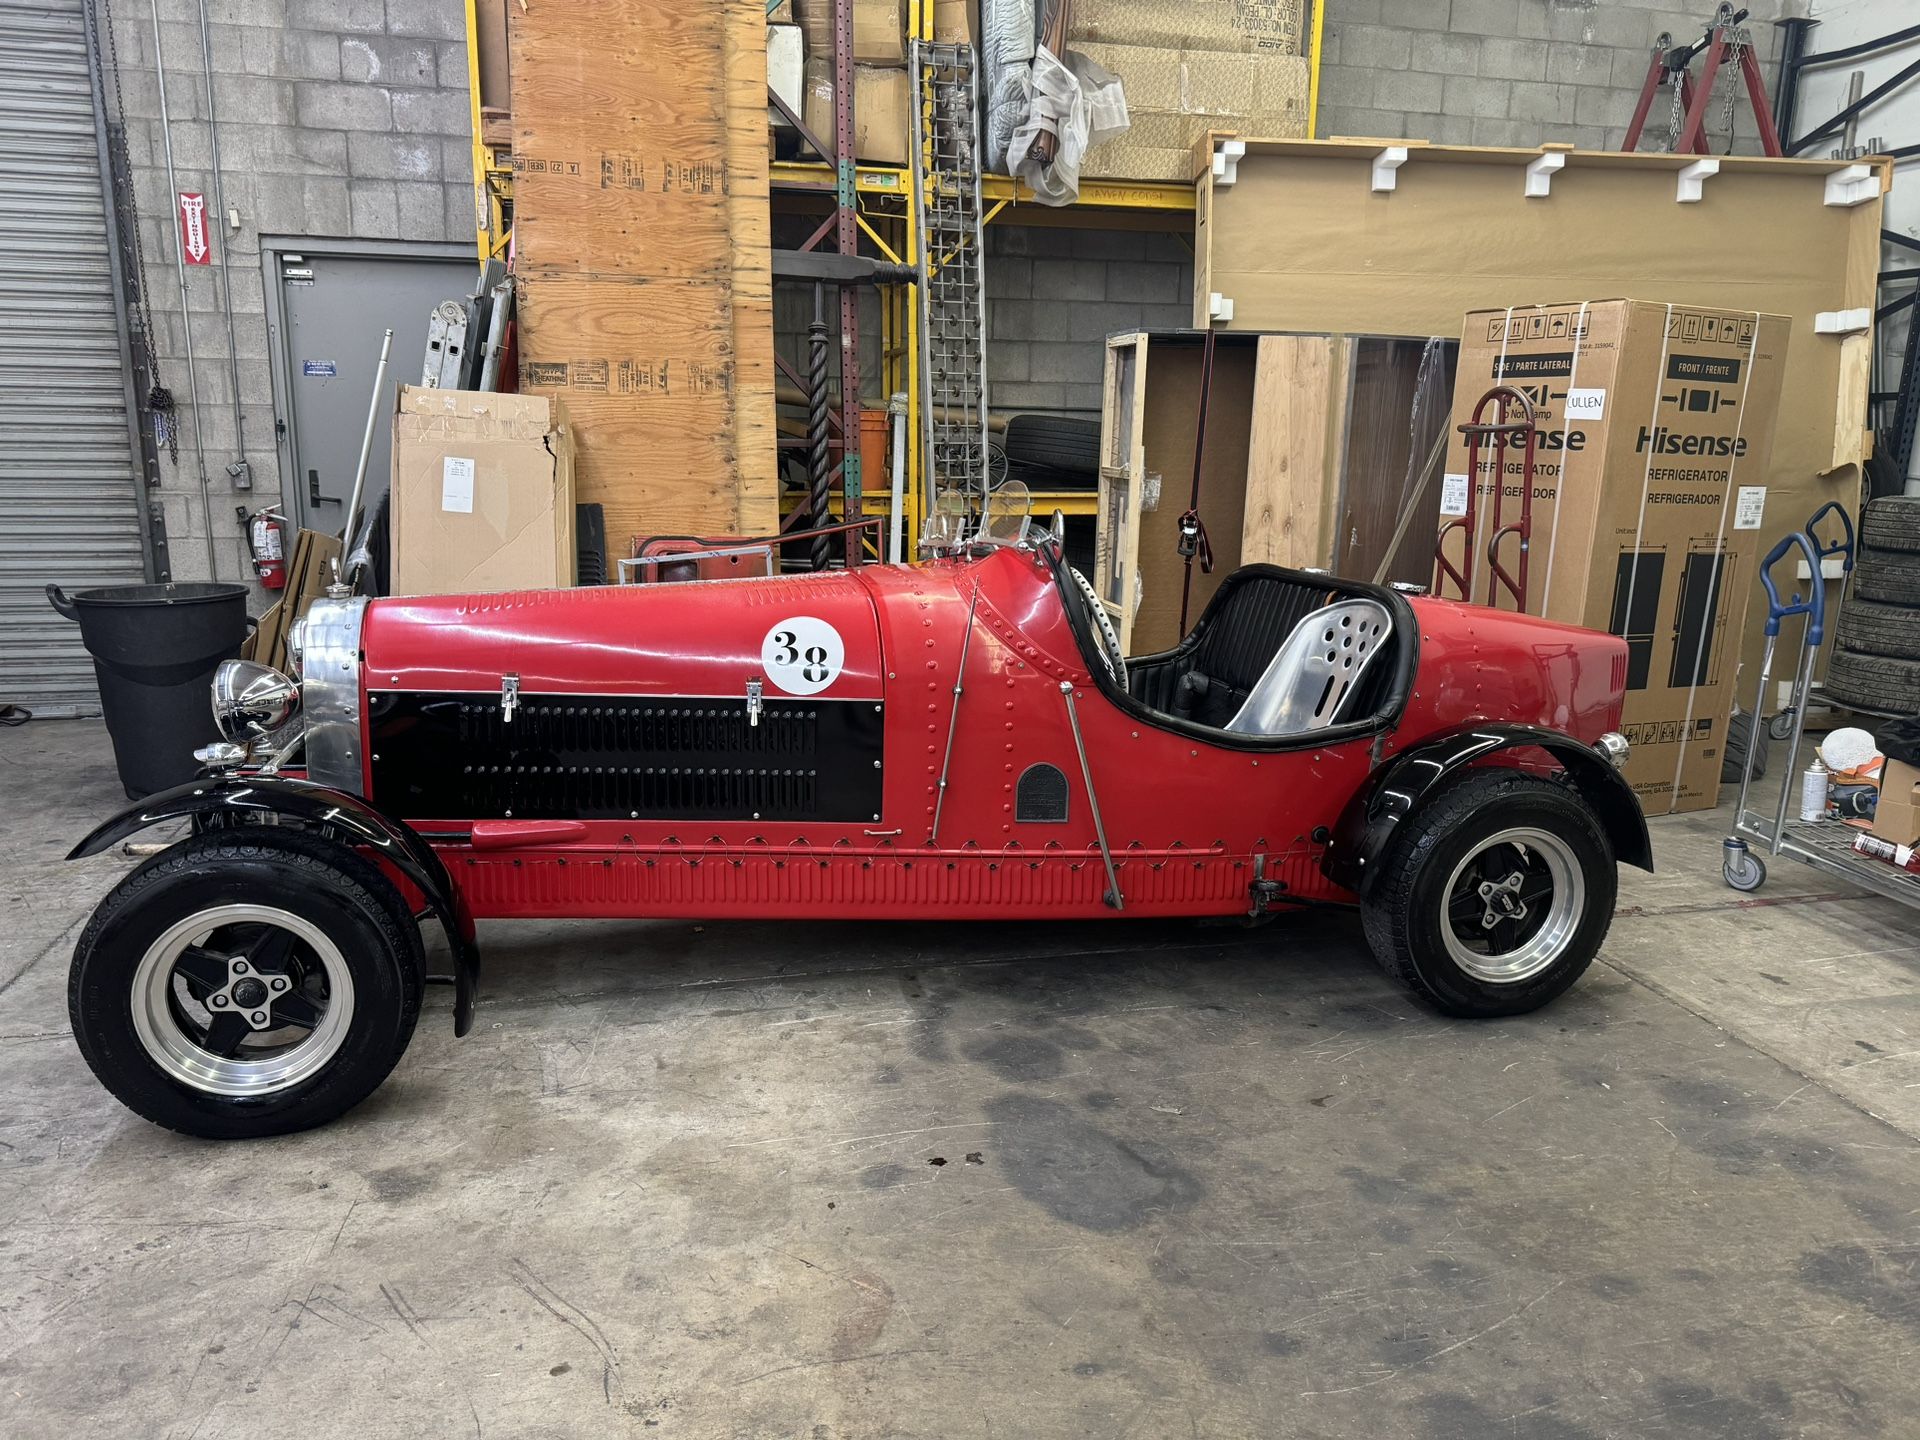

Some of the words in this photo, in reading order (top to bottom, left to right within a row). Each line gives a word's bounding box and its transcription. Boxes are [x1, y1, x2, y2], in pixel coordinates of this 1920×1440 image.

[1236, 3, 1259, 17] PECAN
[1283, 22, 1296, 36] ITEM
[191, 207, 200, 257] EXTINGUISHER
[1744, 323, 1750, 335] 3
[1494, 362, 1510, 372] SDE
[1515, 361, 1537, 370] PARTE
[1540, 360, 1571, 369] LATERAL
[1678, 363, 1700, 373] FRONT
[1705, 365, 1730, 375] FRENTE
[1567, 395, 1604, 408] CULLEN
[1511, 409, 1524, 418] Not
[1635, 426, 1747, 457] Hisense
[1648, 468, 1728, 482] REFRIGERATOR
[1647, 493, 1720, 505] REFRIGERADOR
[775, 631, 829, 682] 38
